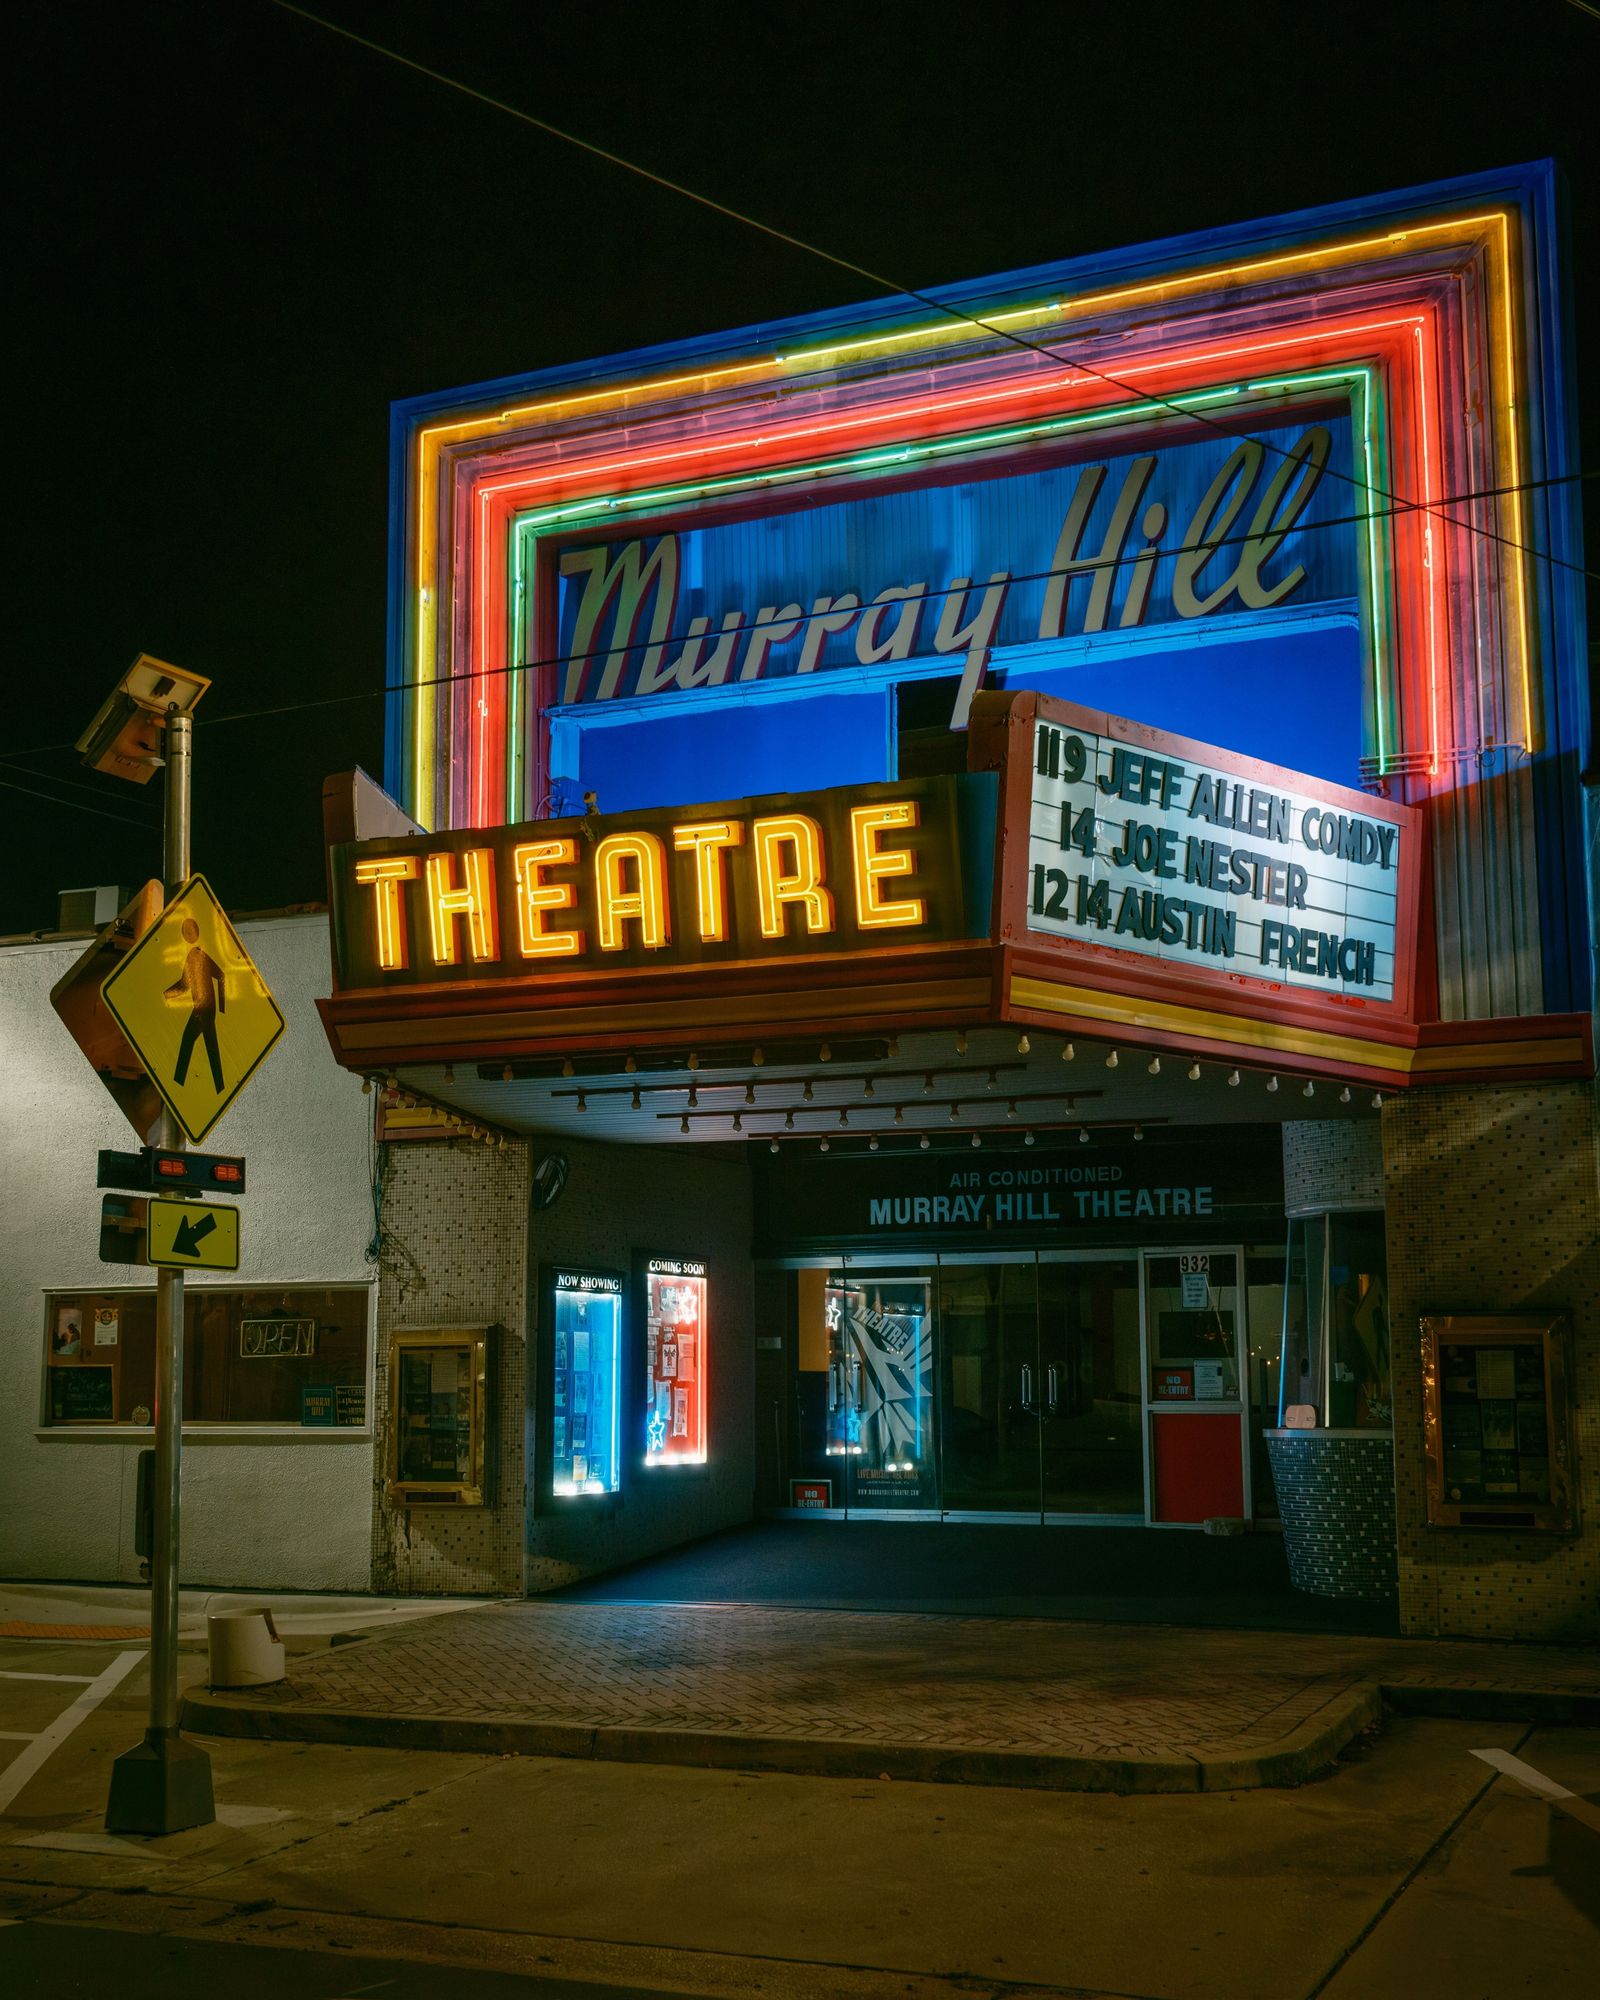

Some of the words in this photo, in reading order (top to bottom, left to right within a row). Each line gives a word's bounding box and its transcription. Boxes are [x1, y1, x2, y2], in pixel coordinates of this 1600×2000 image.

[559, 532, 1013, 732] Murray
[1039, 427, 1333, 640] Hill
[1099, 748, 1185, 810] JEFF
[1188, 774, 1291, 844] ALLEN
[1302, 807, 1396, 870] COMDY
[1060, 801, 1097, 858] 14
[1113, 819, 1178, 879] JOE
[1186, 835, 1308, 910] NESTER
[355, 801, 928, 971] THEATRE
[1033, 864, 1069, 921] 12
[1078, 875, 1111, 930] 14
[1116, 887, 1236, 958] AUSTIN
[1260, 919, 1375, 986] FRENCH
[950, 1173, 980, 1188] AIR
[988, 1166, 1122, 1186] CONDITIONED
[869, 1195, 985, 1225] MURRAY
[995, 1192, 1060, 1221] HILL
[1074, 1187, 1214, 1217] THEATRE
[649, 1259, 682, 1273] COMING
[683, 1262, 705, 1275] SOON
[1180, 1255, 1209, 1273] 932
[558, 1274, 580, 1287] NOW
[580, 1276, 619, 1290] SHOWING
[244, 1323, 312, 1354] OPEN
[852, 1305, 909, 1351] THEATRE
[1166, 1375, 1181, 1385] NO
[804, 1490, 818, 1498] NO
